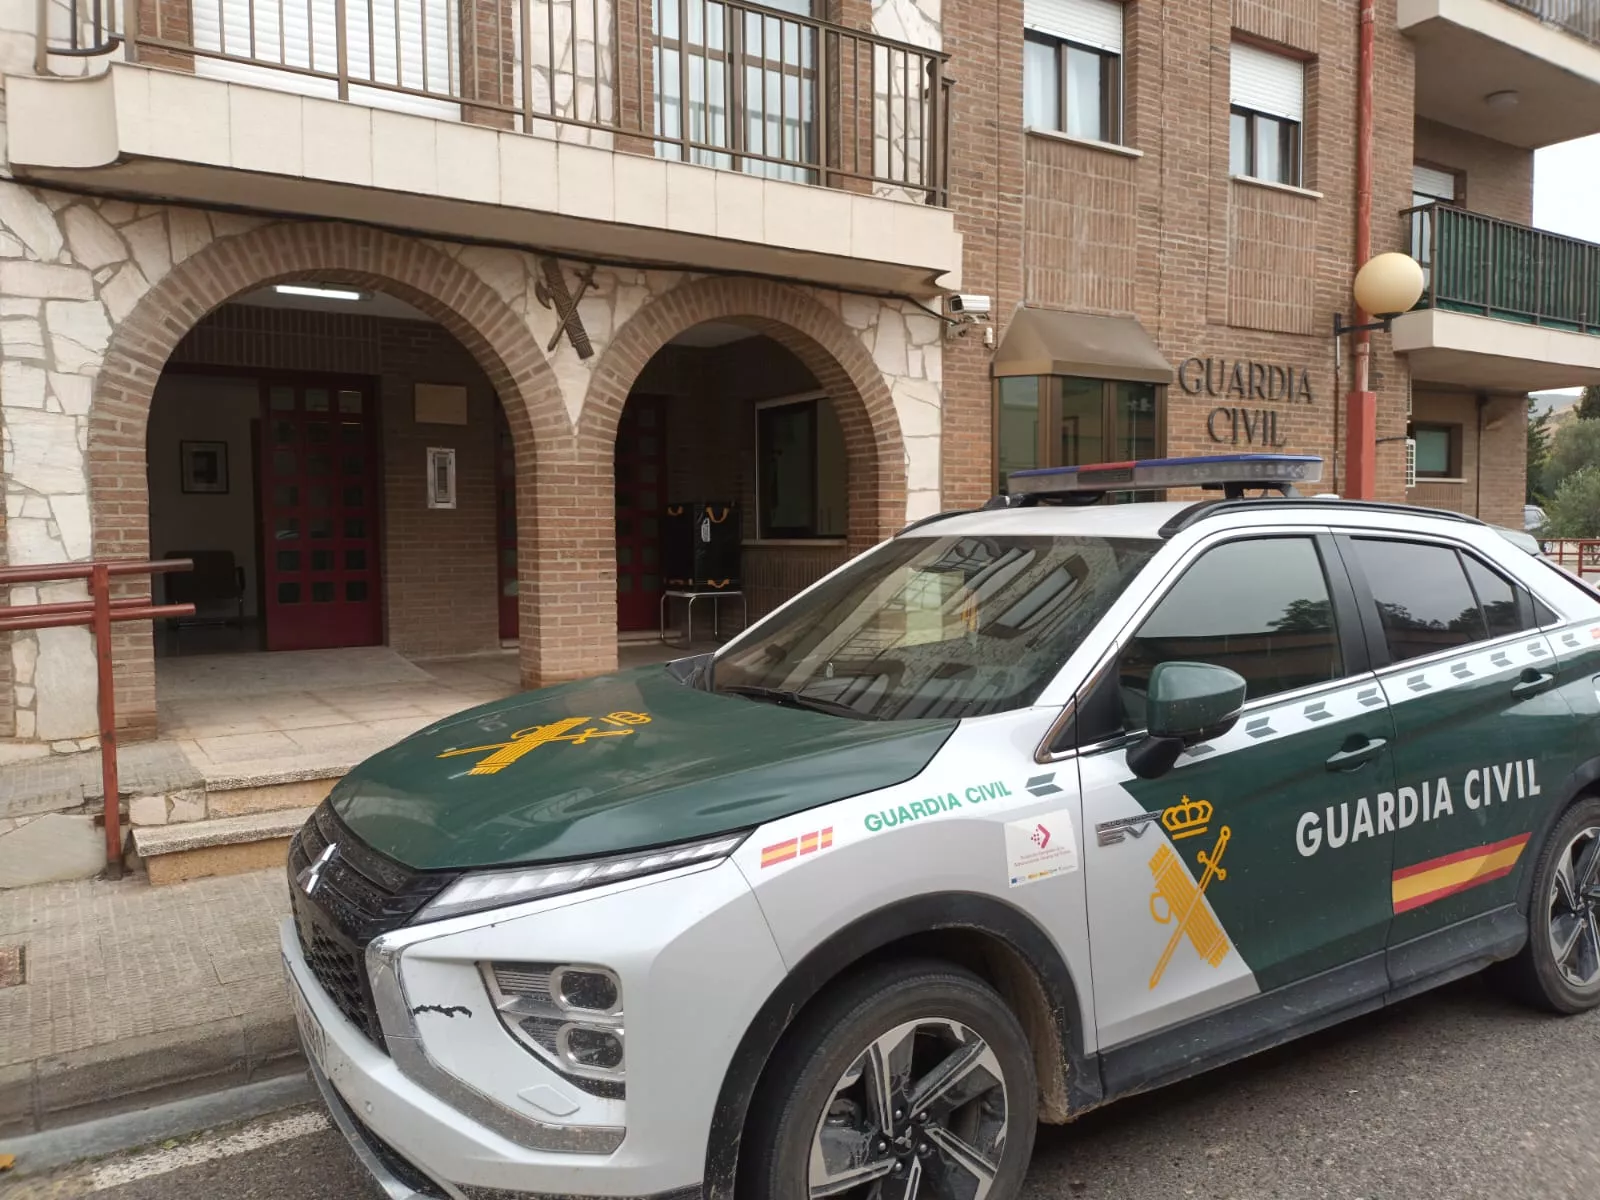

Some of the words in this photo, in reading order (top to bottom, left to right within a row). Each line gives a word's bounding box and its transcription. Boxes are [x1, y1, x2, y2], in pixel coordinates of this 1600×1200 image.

[1178, 357, 1313, 404] GUARDIA
[1207, 407, 1287, 447] CIVIL
[864, 793, 963, 832] GUARDIA
[965, 781, 1012, 804] CIVIL
[1296, 777, 1454, 857] GUARDIA
[1464, 758, 1541, 810] CIVIL
[1097, 821, 1153, 847] EV
